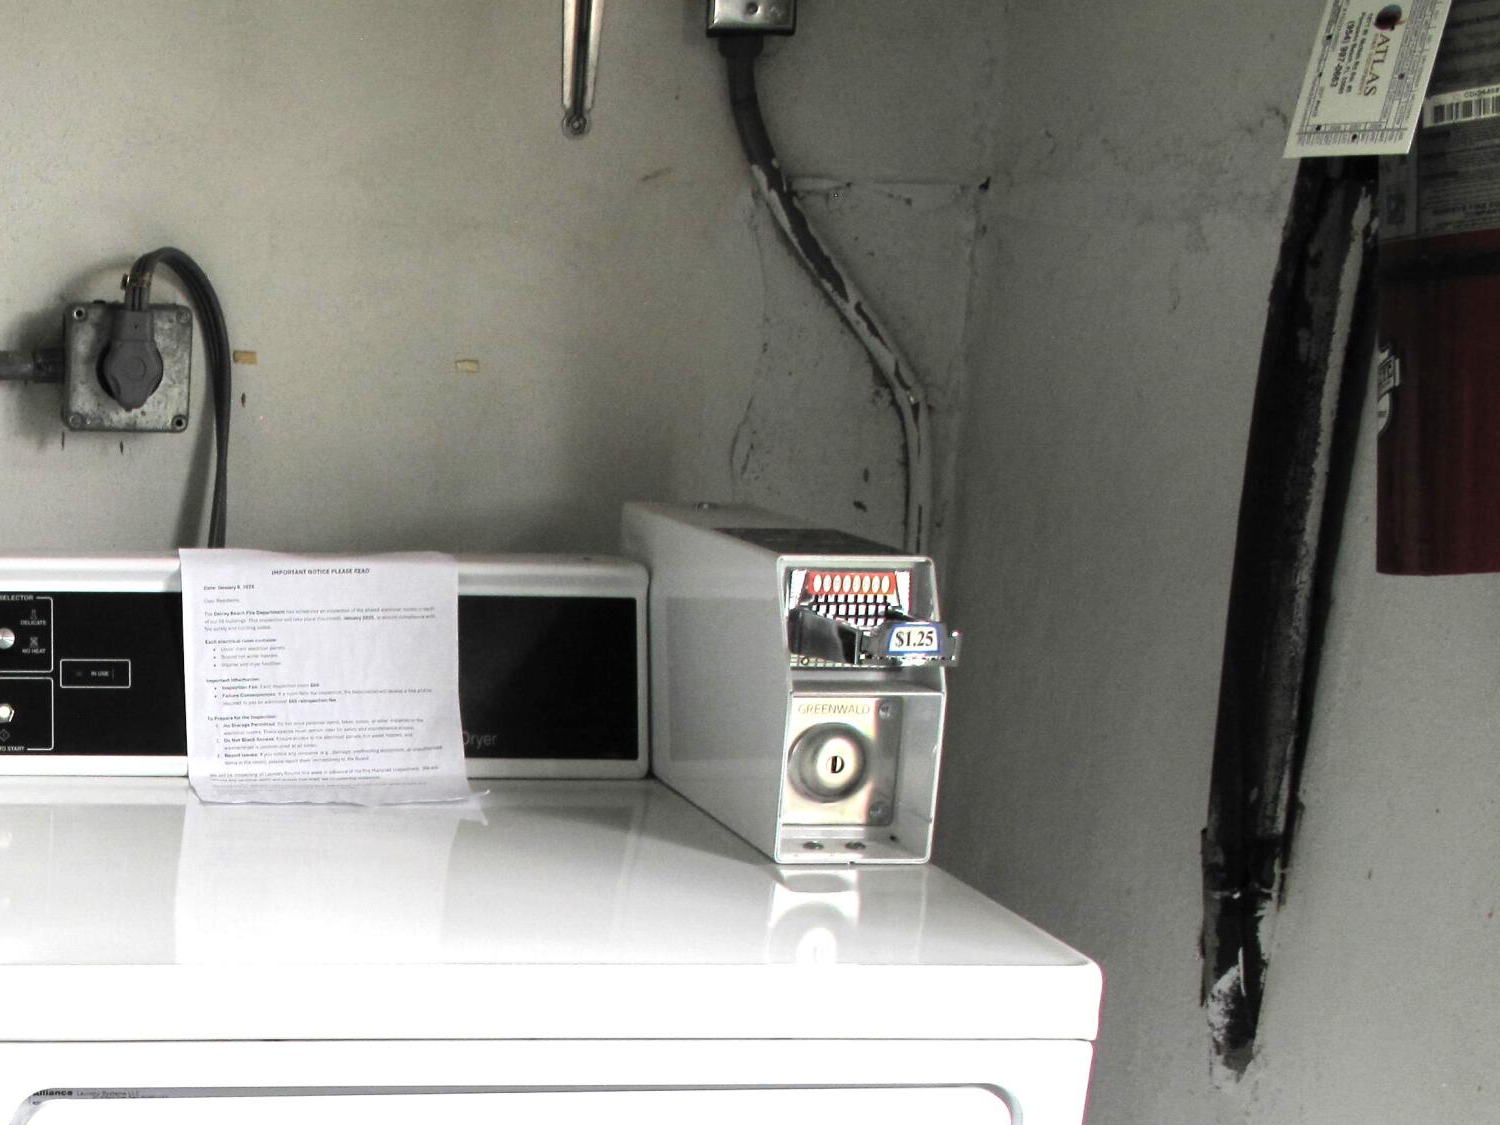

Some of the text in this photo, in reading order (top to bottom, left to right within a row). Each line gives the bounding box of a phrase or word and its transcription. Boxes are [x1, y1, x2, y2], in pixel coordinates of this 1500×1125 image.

[1364, 33, 1390, 97] ATLAS
[895, 631, 934, 648] $1.25
[798, 704, 870, 714] GREENWALD
